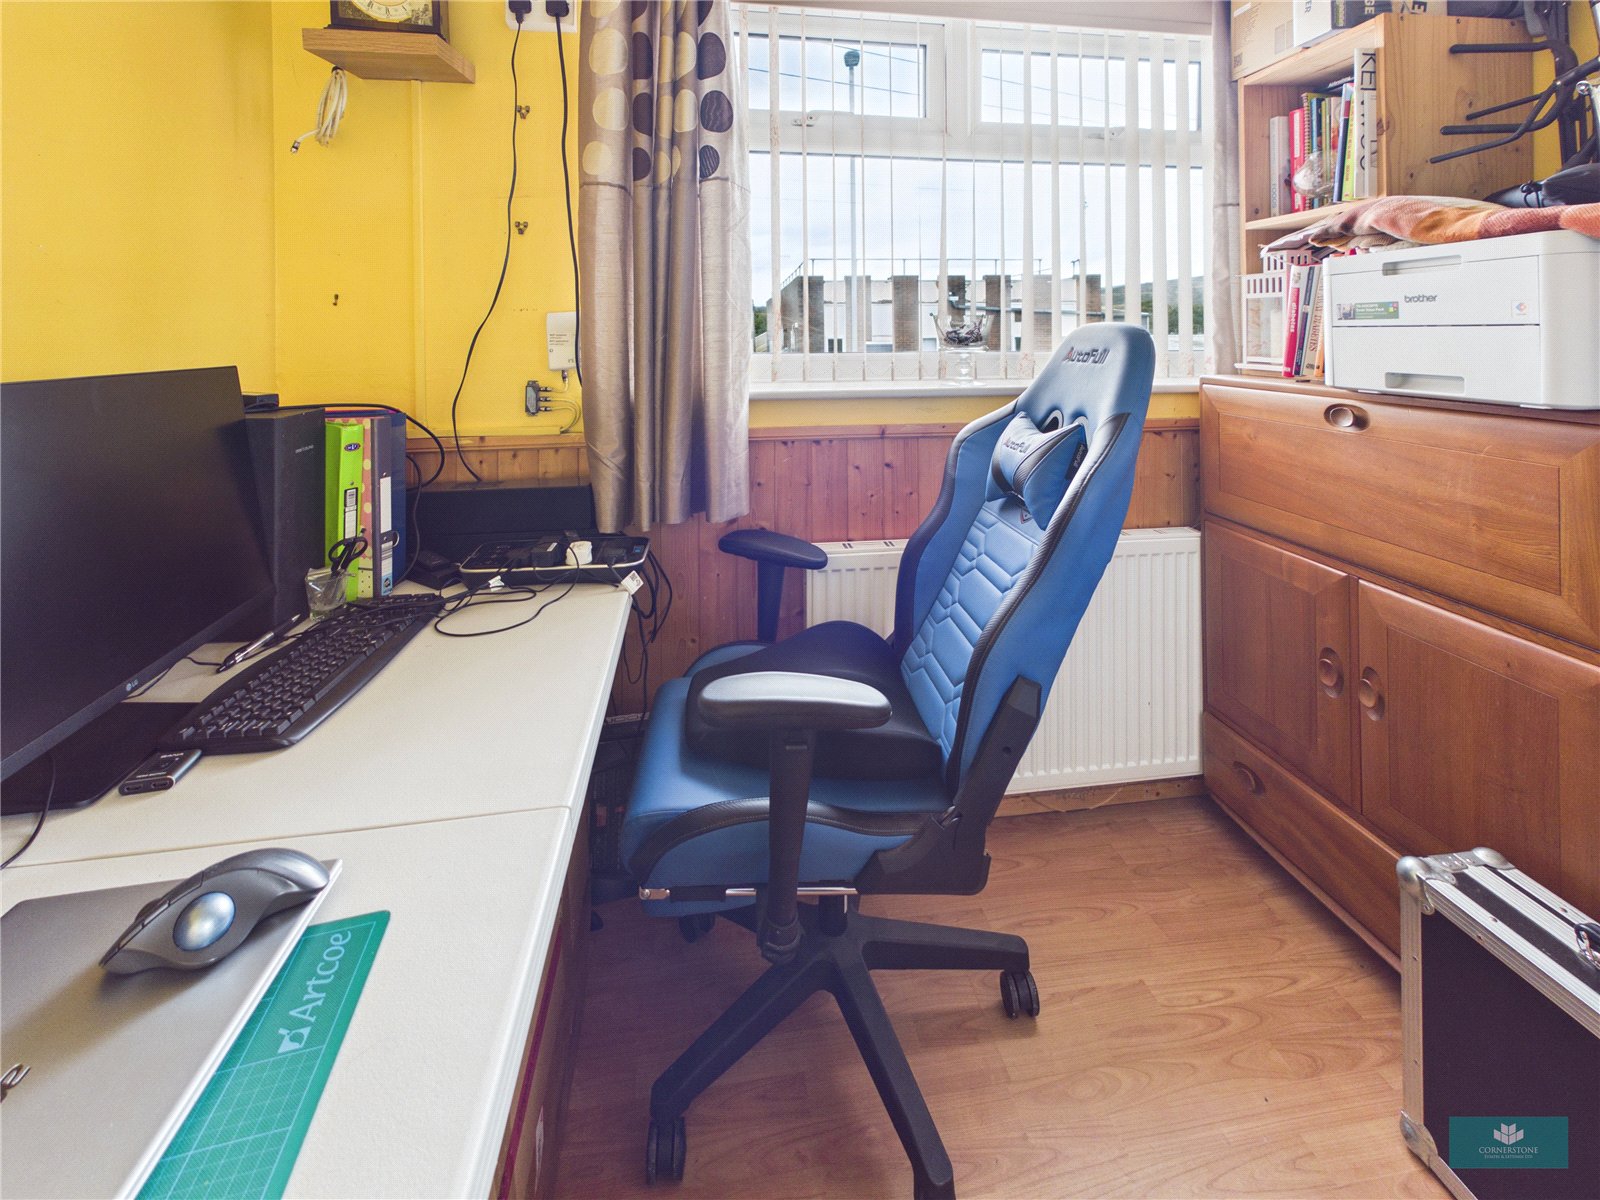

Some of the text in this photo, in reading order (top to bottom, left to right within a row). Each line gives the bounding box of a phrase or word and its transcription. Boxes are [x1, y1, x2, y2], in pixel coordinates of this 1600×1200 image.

[1404, 294, 1438, 303] brother
[1290, 302, 1298, 333] diabetes
[1062, 346, 1110, 364] AutoFull
[288, 930, 352, 1022] Artcoe
